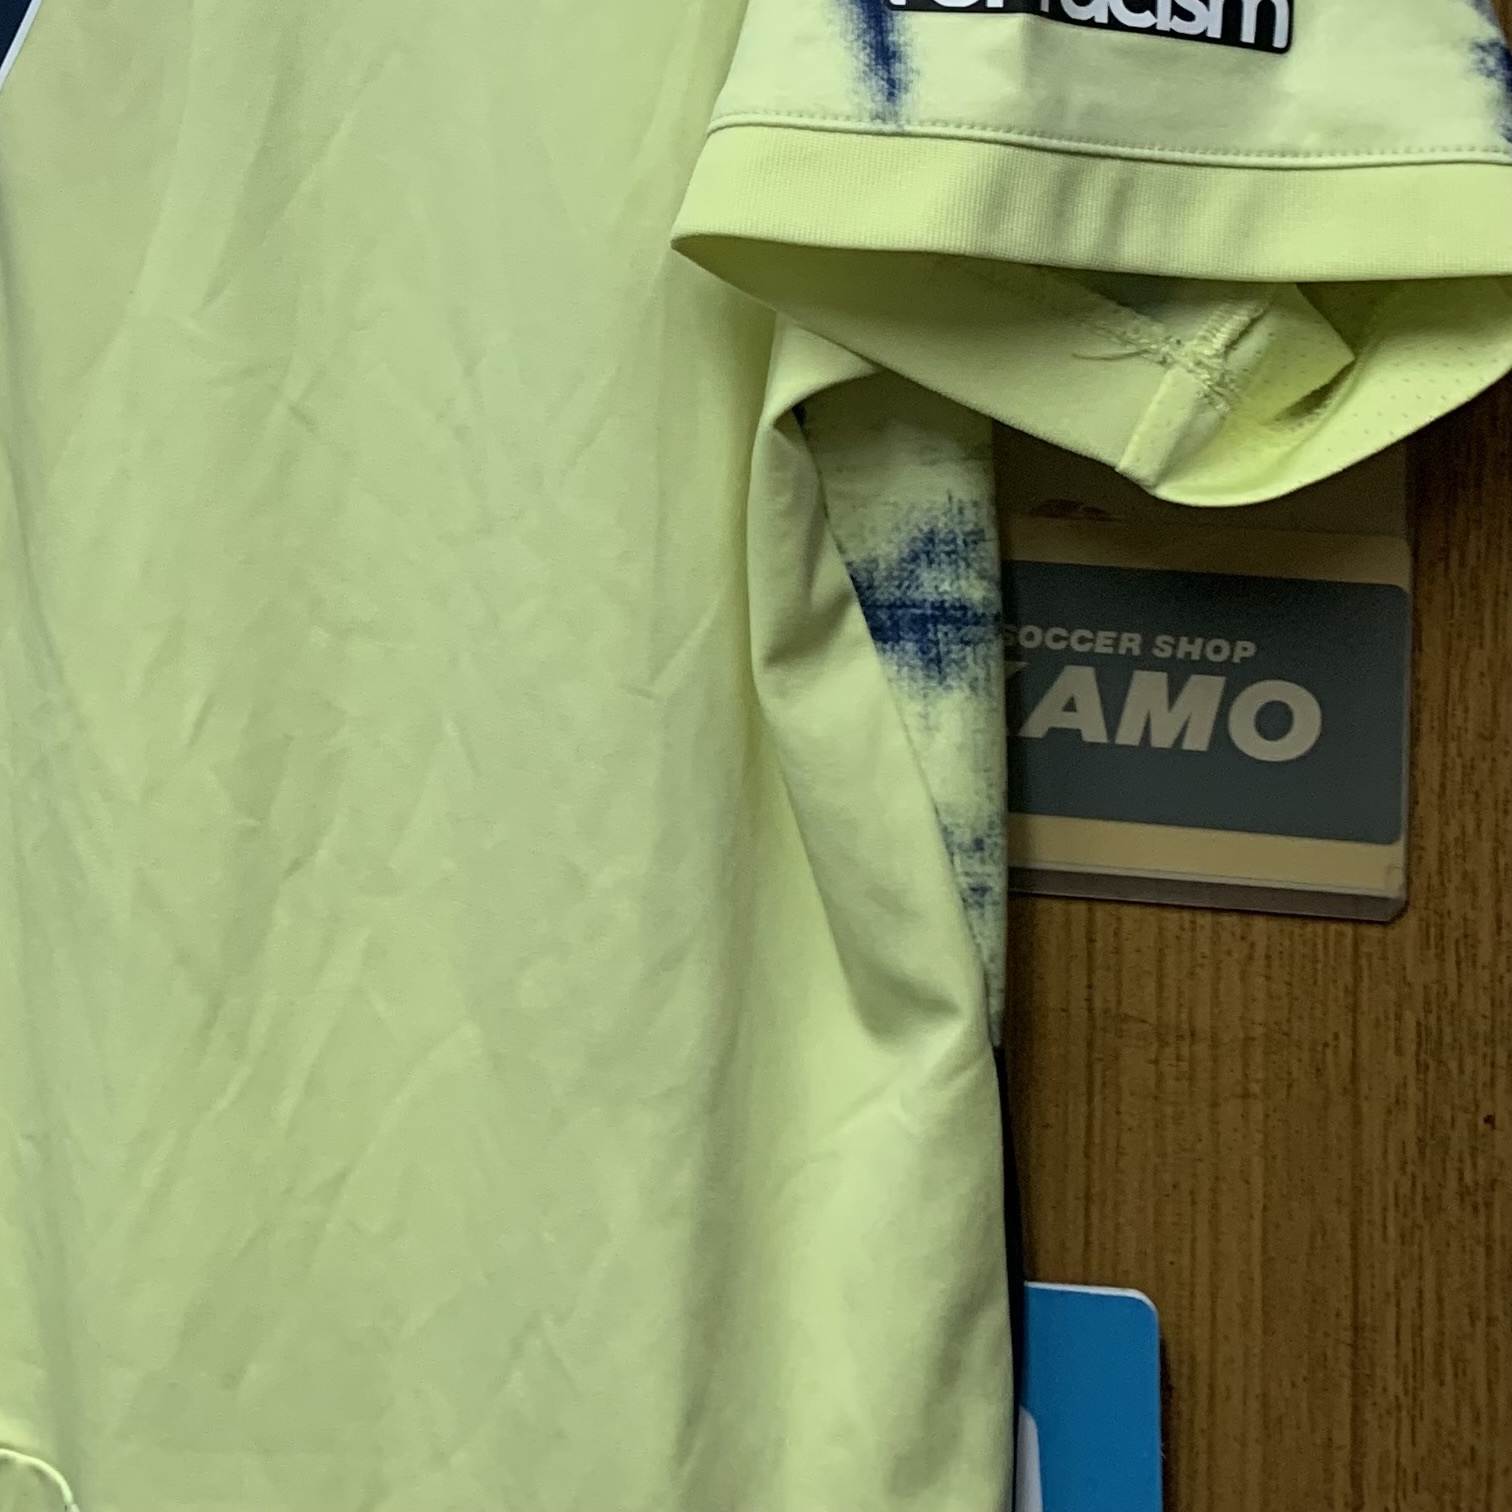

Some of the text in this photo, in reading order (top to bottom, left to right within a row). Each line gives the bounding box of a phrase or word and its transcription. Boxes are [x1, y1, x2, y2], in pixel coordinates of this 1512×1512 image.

[1001, 624, 1258, 664] SOCCER SHOP
[1004, 661, 1324, 763] AMO
